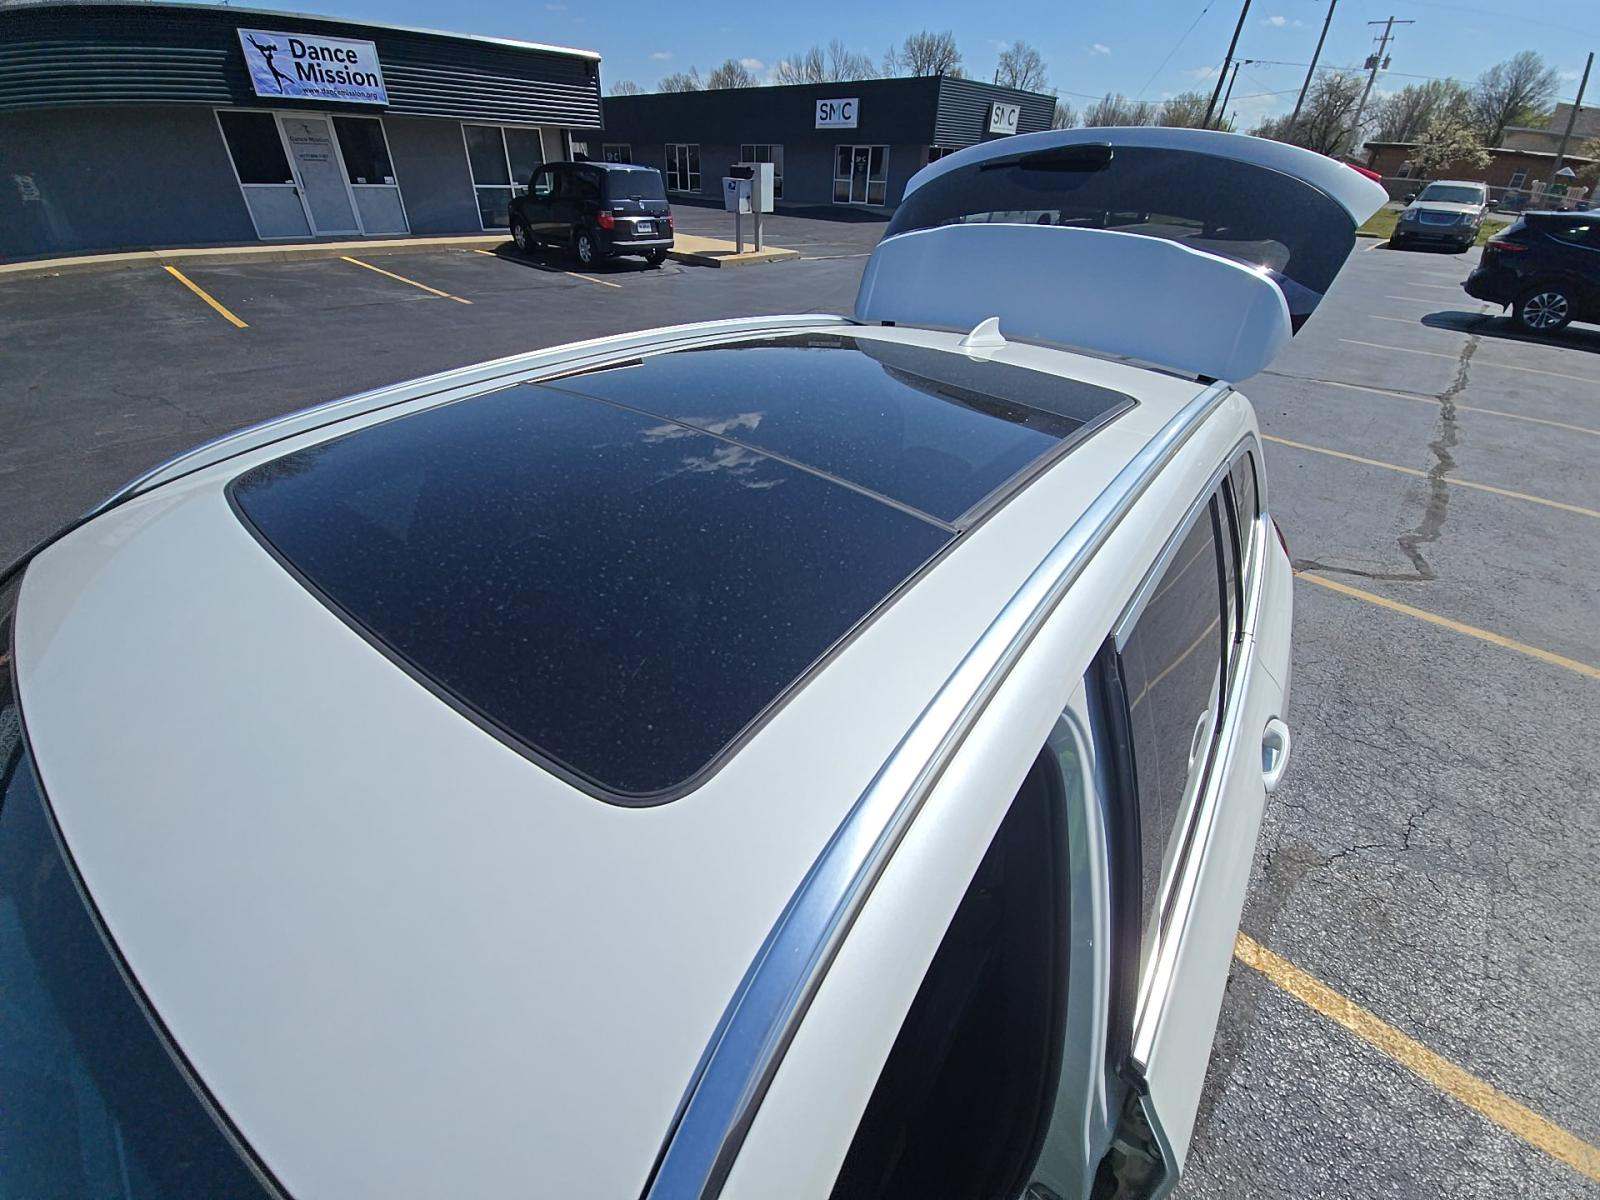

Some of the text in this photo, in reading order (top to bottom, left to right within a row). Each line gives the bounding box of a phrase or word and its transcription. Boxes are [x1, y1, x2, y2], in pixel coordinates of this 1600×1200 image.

[288, 38, 358, 64] Dance
[294, 61, 379, 87] Mission
[819, 102, 852, 120] SMC
